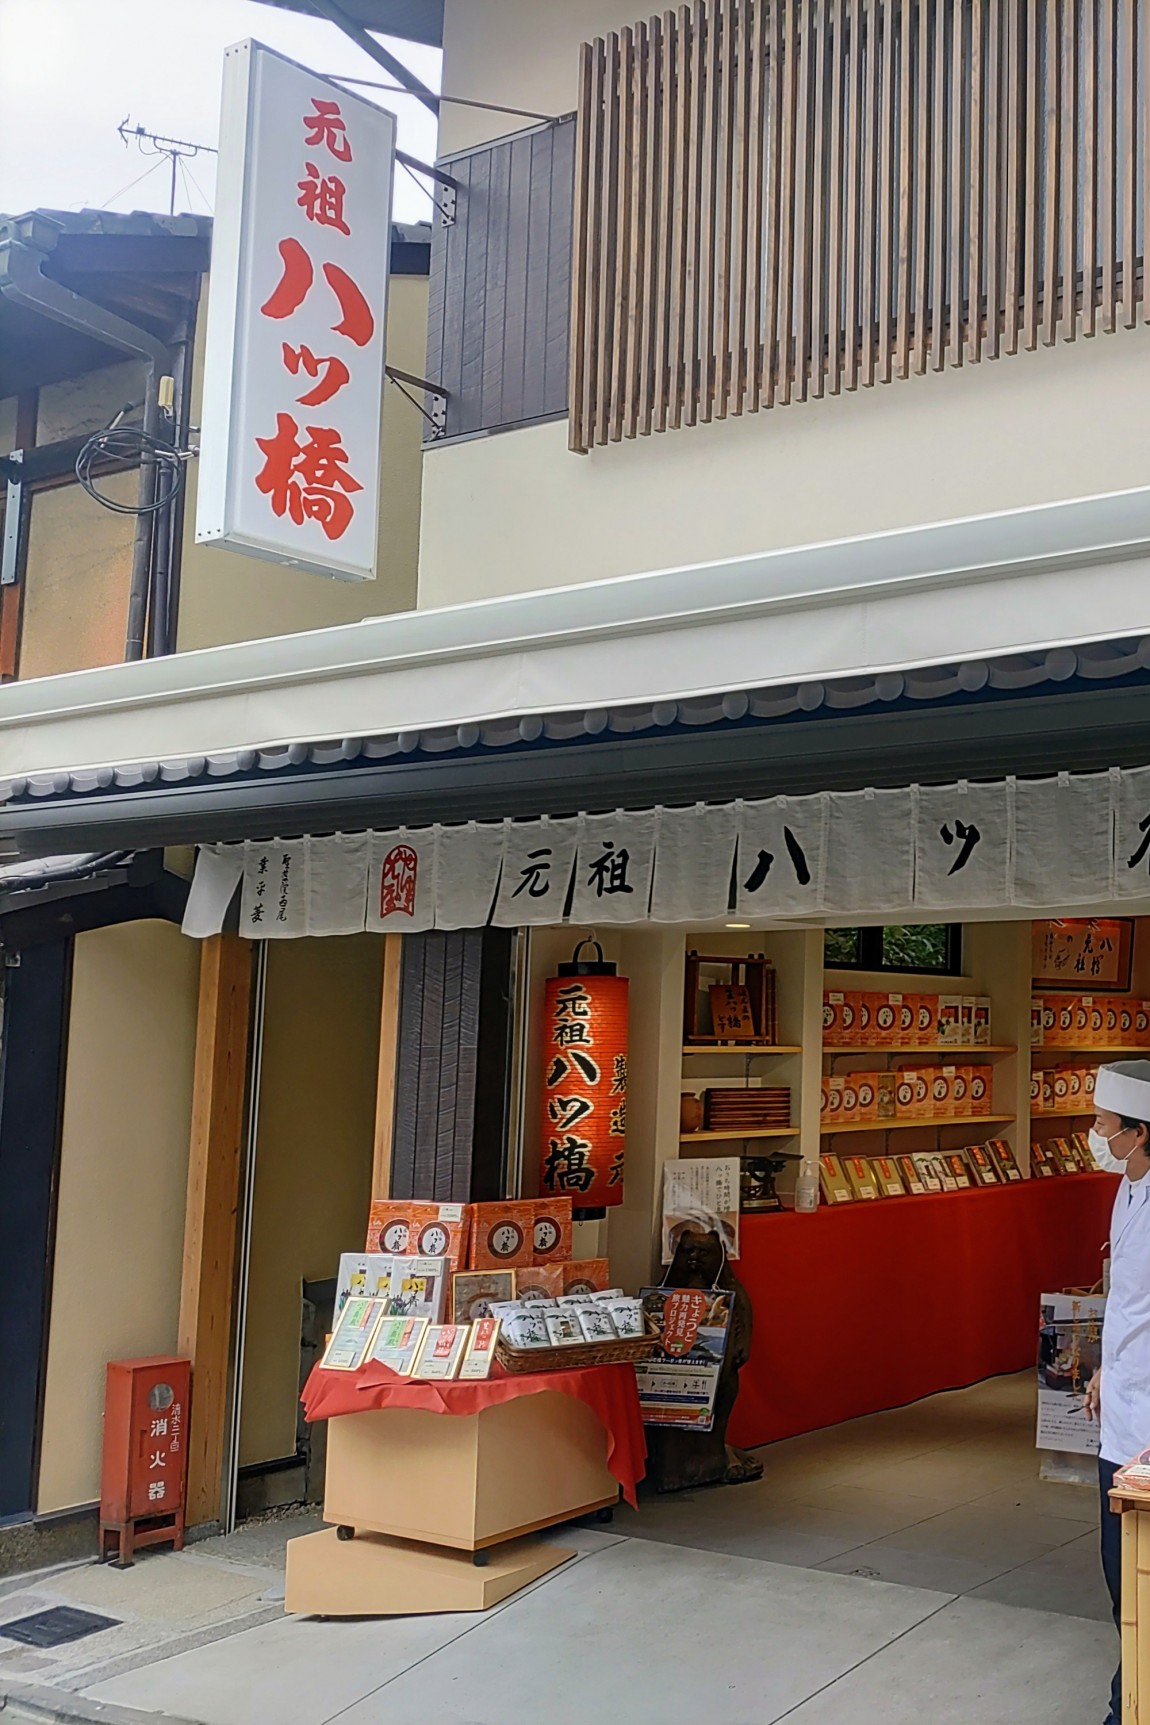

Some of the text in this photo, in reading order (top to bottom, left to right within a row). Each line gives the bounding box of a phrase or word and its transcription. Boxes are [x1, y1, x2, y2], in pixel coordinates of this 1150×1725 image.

[684, 1295, 702, 1342] きょうと
[148, 1418, 168, 1500] 消火器
